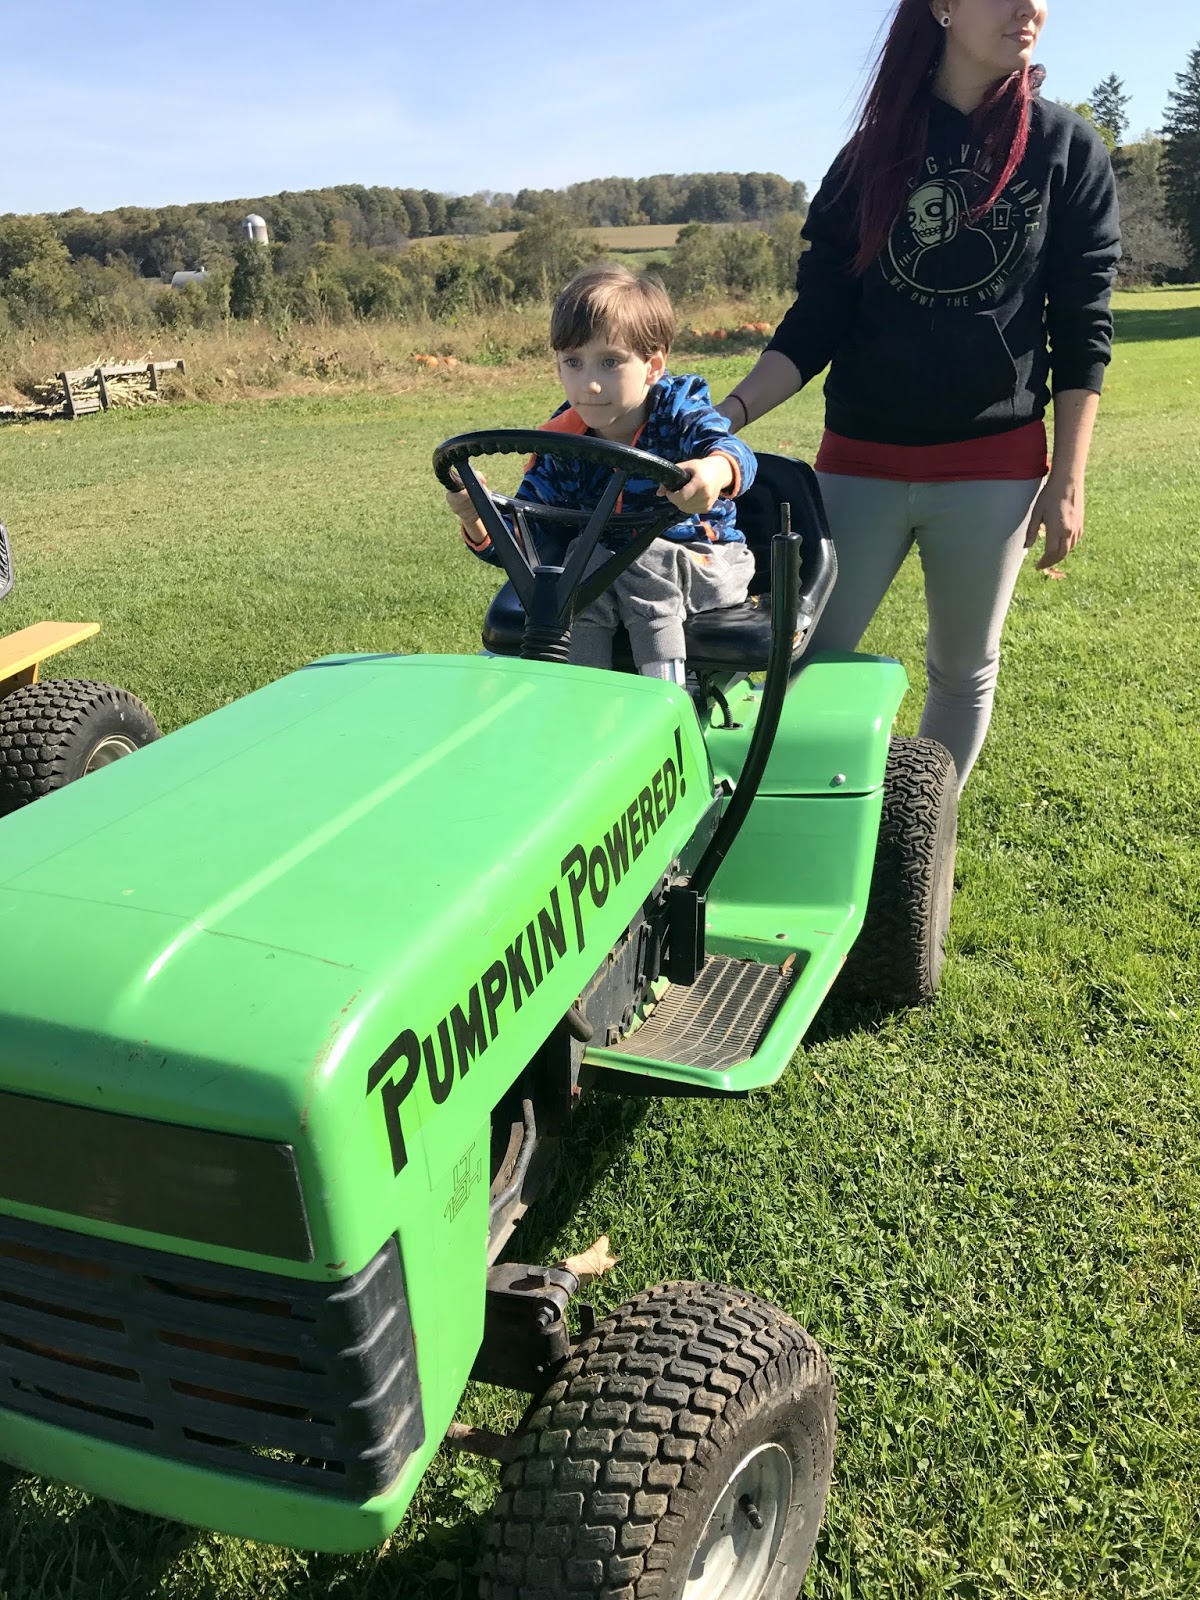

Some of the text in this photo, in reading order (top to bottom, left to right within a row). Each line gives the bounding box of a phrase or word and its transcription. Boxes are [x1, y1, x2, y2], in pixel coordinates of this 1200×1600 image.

[1009, 169, 1043, 233] ANCE
[889, 275, 907, 292] WE
[946, 295, 969, 307] THE
[978, 269, 1010, 302] NIGHT
[365, 725, 687, 1179] PUMPKIN POWERED!
[452, 1140, 475, 1192] LT
